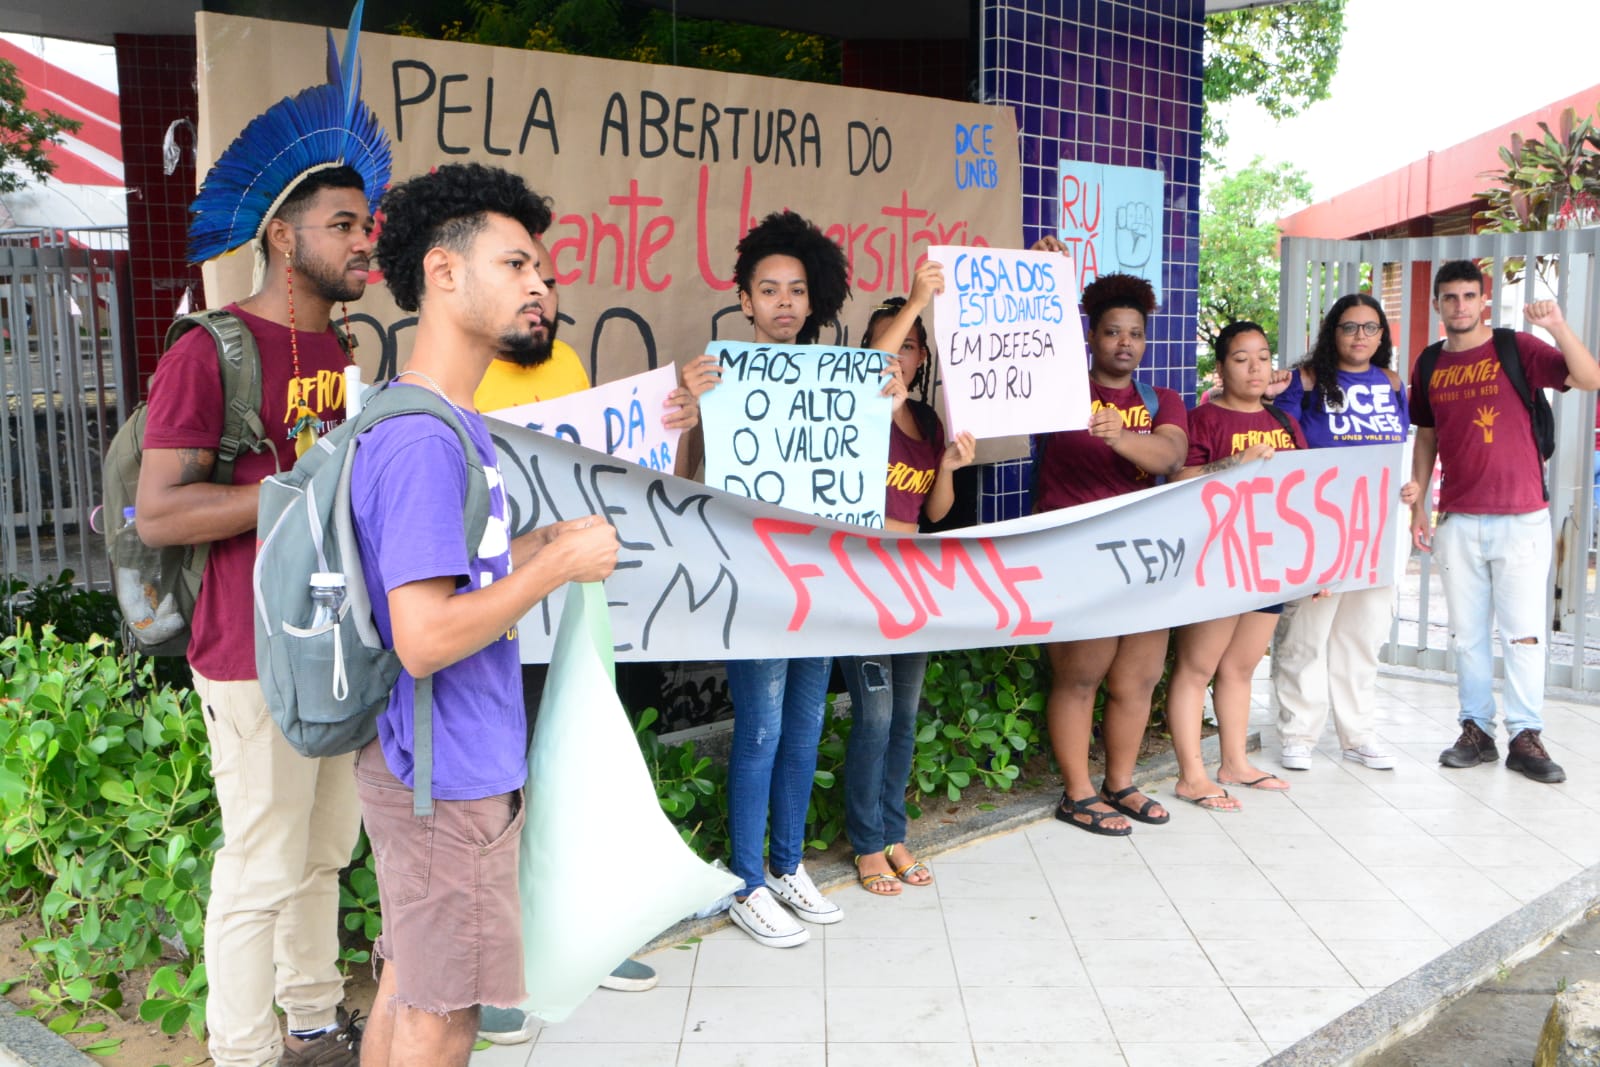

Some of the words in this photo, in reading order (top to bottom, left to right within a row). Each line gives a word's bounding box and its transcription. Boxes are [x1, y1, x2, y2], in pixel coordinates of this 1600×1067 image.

[392, 59, 560, 156] PELA
[600, 90, 821, 168] ABERTURA
[847, 119, 892, 176] DO
[955, 123, 994, 155] DCE
[955, 159, 998, 190] UNEB
[954, 253, 1013, 292] CASA
[1016, 259, 1056, 292] DOS
[958, 292, 1063, 328] ESTUDANTES
[718, 347, 806, 385] MÃOS
[817, 351, 884, 385] PARA
[950, 331, 982, 366] EM
[988, 332, 1055, 361] DEFESA
[283, 369, 347, 424] AFRO
[744, 388, 771, 422] O
[788, 387, 857, 422] ALTO
[970, 371, 997, 400] DO
[603, 386, 646, 455] DÁ
[1328, 414, 1403, 435] UNEB
[732, 427, 760, 466] O
[775, 424, 860, 463] VALOR
[812, 468, 864, 506] RU
[752, 517, 1054, 640] FOME
[1096, 537, 1186, 585] TEM
[1195, 466, 1391, 594] PRESSA!
